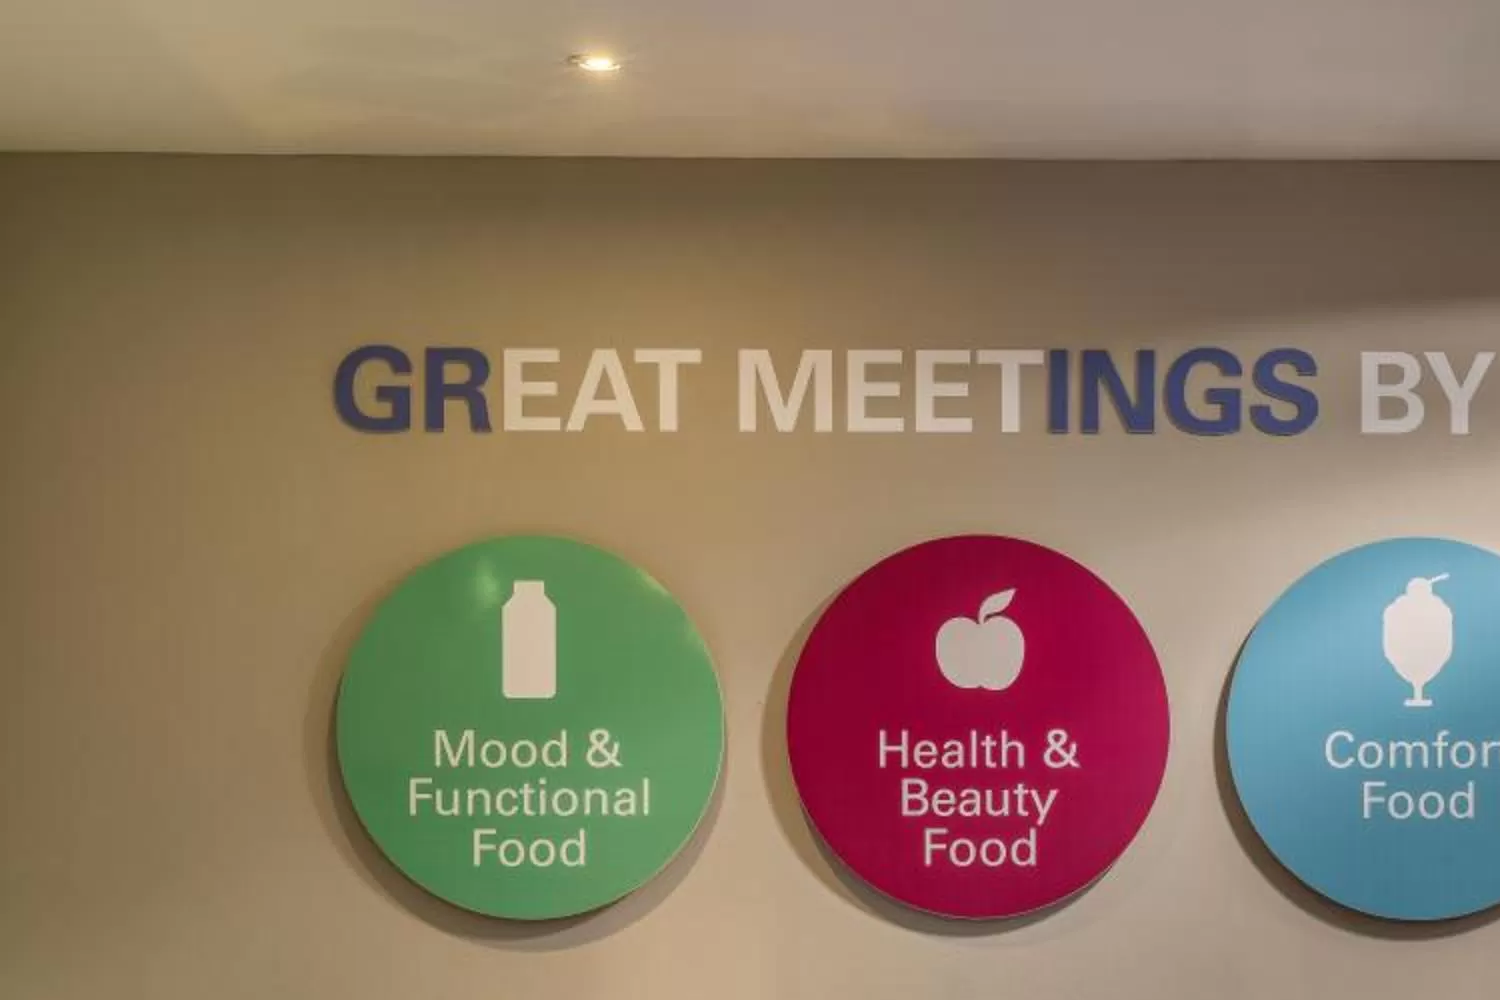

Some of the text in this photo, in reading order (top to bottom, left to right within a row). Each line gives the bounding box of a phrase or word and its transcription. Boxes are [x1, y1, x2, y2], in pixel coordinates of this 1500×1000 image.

[333, 345, 702, 435] GREAT
[738, 346, 1319, 437] MEETINGS
[1360, 351, 1495, 434] BY
[434, 728, 624, 769] Mood &
[878, 730, 1080, 769] Health &
[409, 776, 651, 818] Functional
[901, 778, 1057, 825] Beauty
[1362, 780, 1476, 820] Food
[472, 827, 586, 868] Food
[924, 828, 1037, 867] Food
